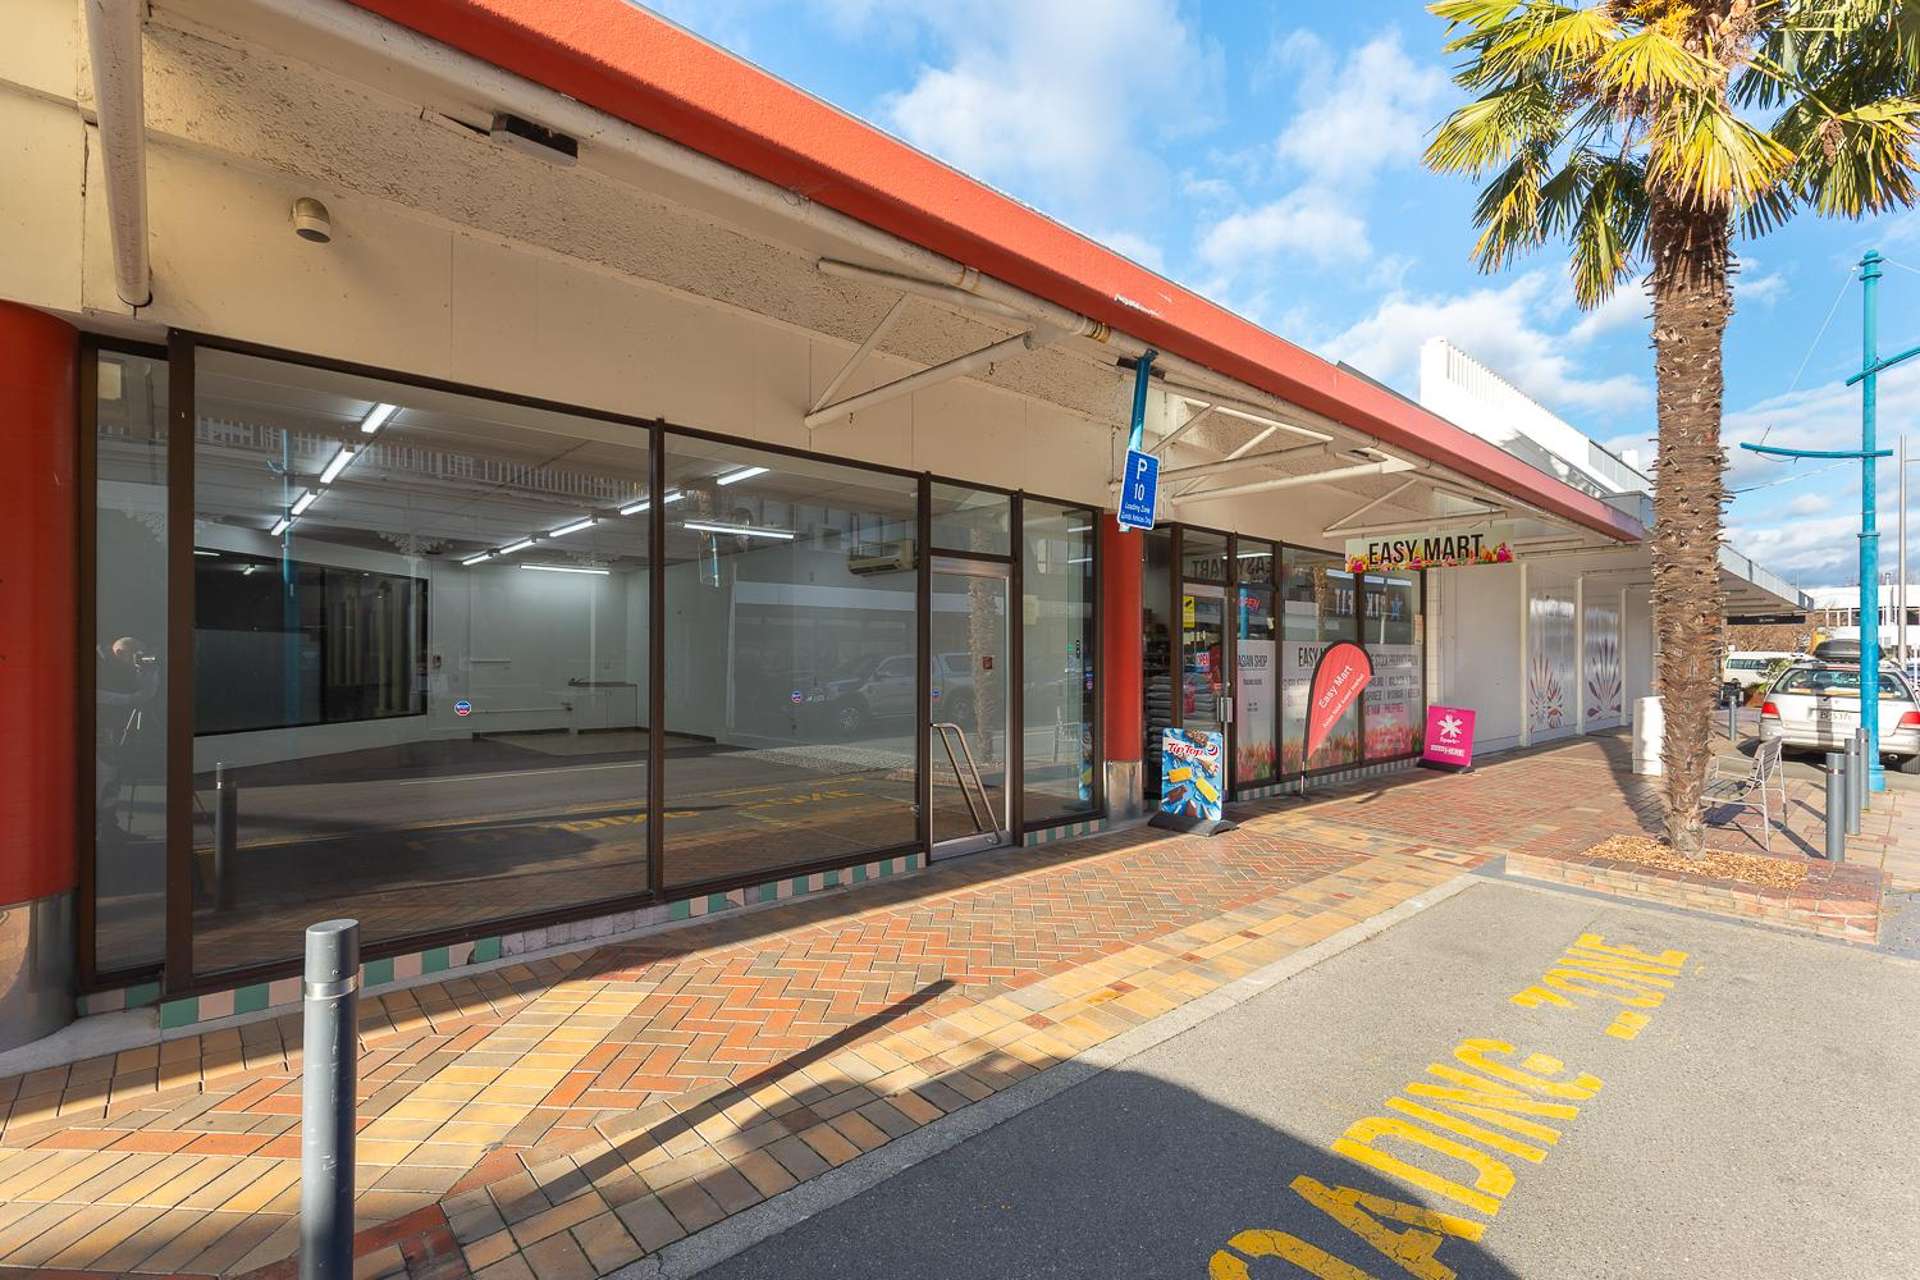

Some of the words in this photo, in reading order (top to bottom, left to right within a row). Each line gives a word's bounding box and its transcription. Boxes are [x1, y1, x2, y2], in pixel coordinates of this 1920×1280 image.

[1136, 458, 1148, 480] P
[1133, 483, 1145, 501] 10
[1368, 539, 1418, 565] EASY
[1423, 533, 1484, 562] MART
[1298, 647, 1319, 668] EASY
[1318, 685, 1338, 709] Easy
[1336, 664, 1353, 688] Mart
